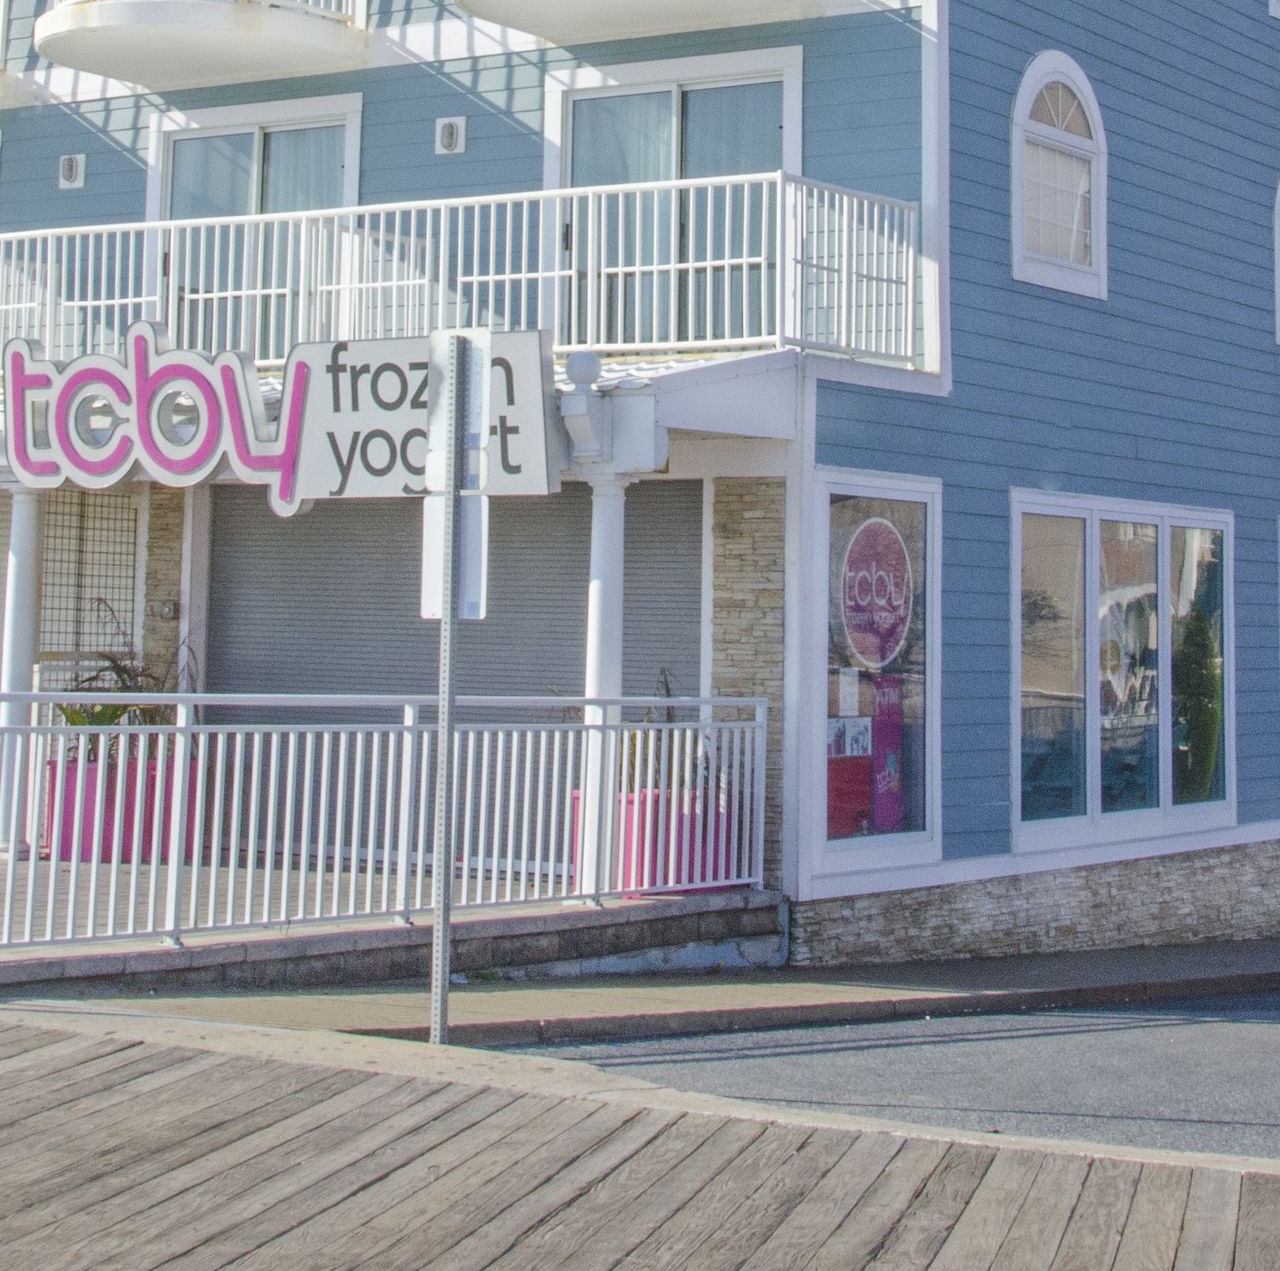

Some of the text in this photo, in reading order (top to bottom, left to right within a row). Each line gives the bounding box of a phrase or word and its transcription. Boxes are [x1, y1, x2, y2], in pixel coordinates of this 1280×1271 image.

[11, 334, 308, 502] tcby
[326, 342, 516, 413] frozn
[328, 416, 522, 497] yogt
